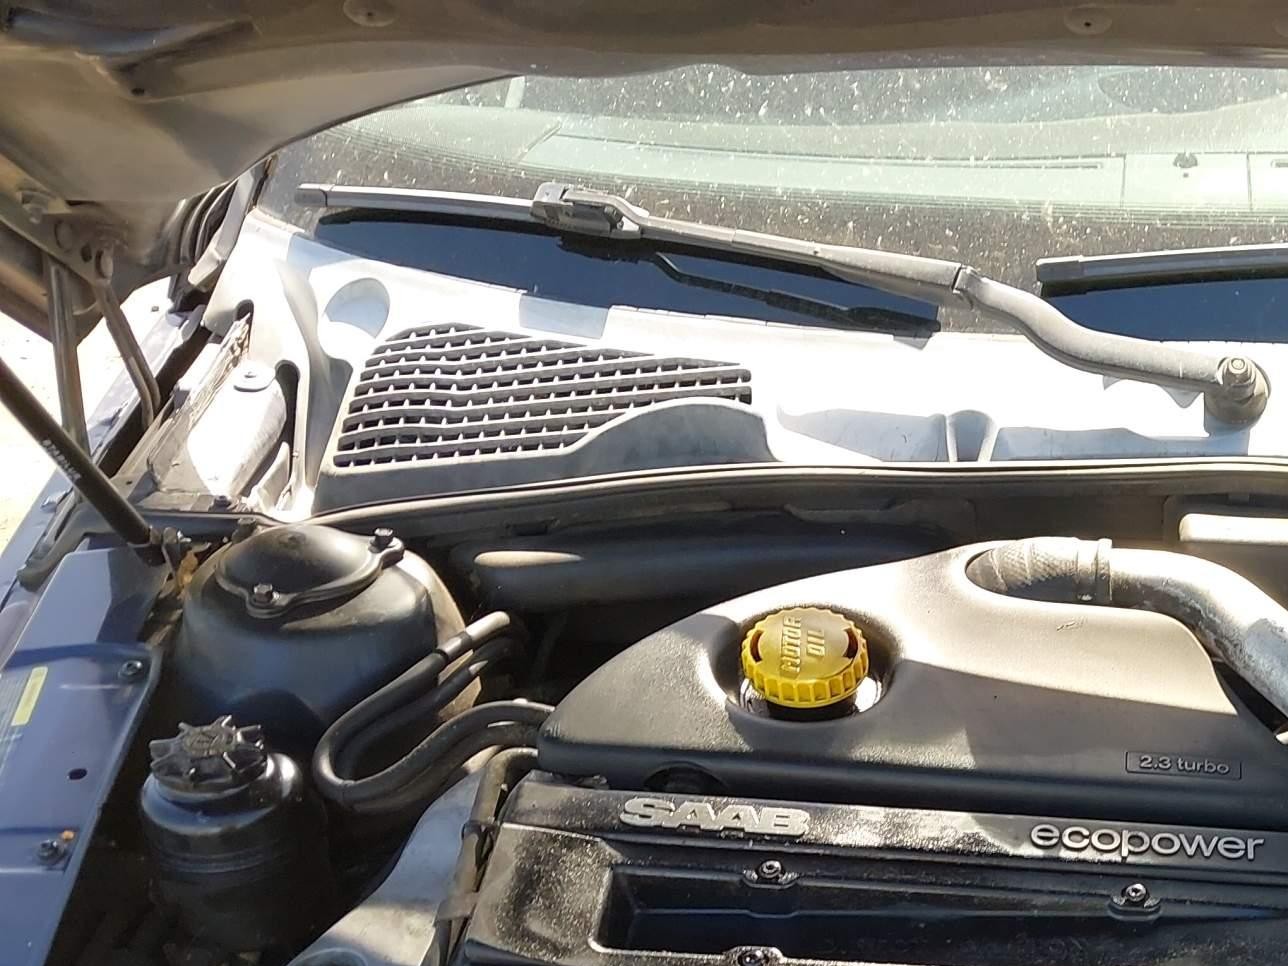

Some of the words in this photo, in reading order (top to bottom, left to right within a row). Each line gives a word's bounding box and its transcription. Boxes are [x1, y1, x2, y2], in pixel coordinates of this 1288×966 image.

[781, 617, 802, 673] MOTOR
[807, 628, 825, 657] OIL
[1140, 755, 1171, 770] 2.3
[1177, 757, 1230, 774] turbo
[619, 797, 811, 836] SAAB
[1031, 824, 1264, 860] ecopower
